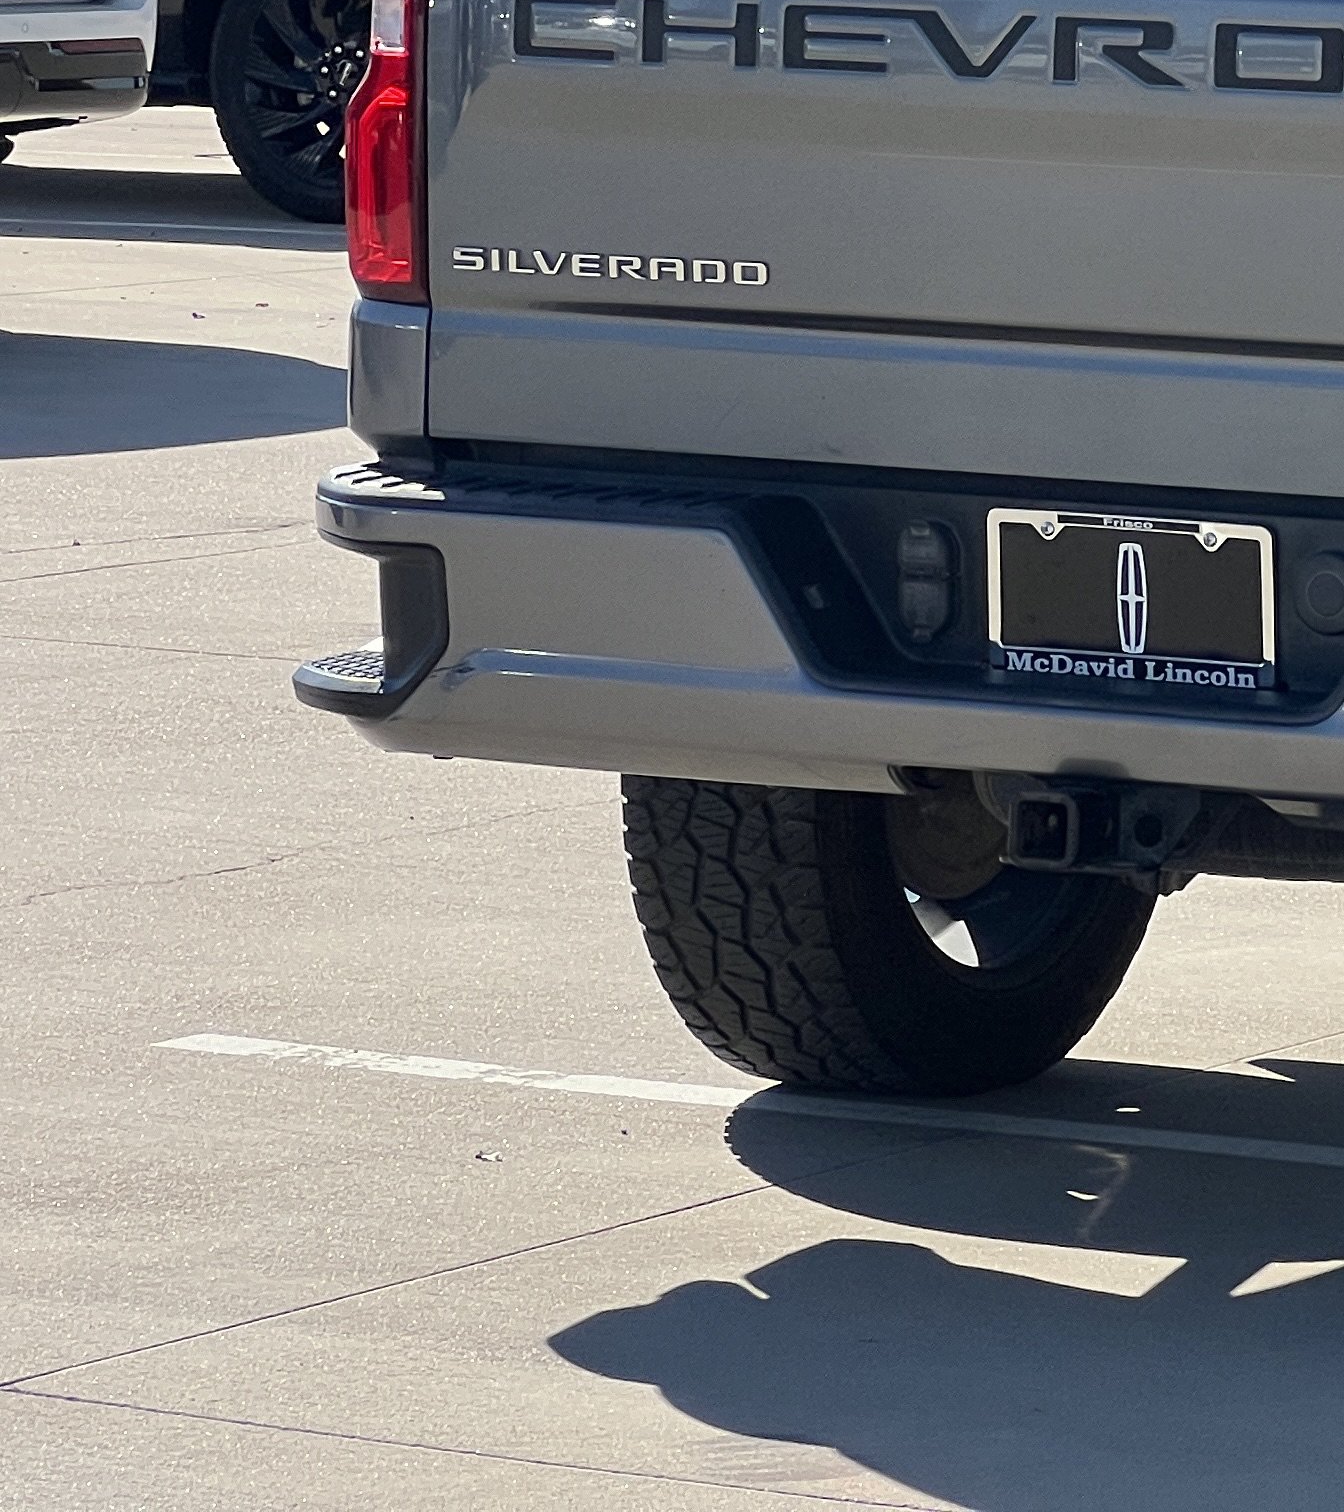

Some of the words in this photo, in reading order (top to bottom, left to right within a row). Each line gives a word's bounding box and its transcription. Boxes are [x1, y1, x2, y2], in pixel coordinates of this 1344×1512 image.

[452, 246, 770, 287] SILVERADO
[1103, 517, 1154, 530] Frisco
[1007, 651, 1136, 679] McDavid
[1145, 661, 1257, 689] Lincoln
